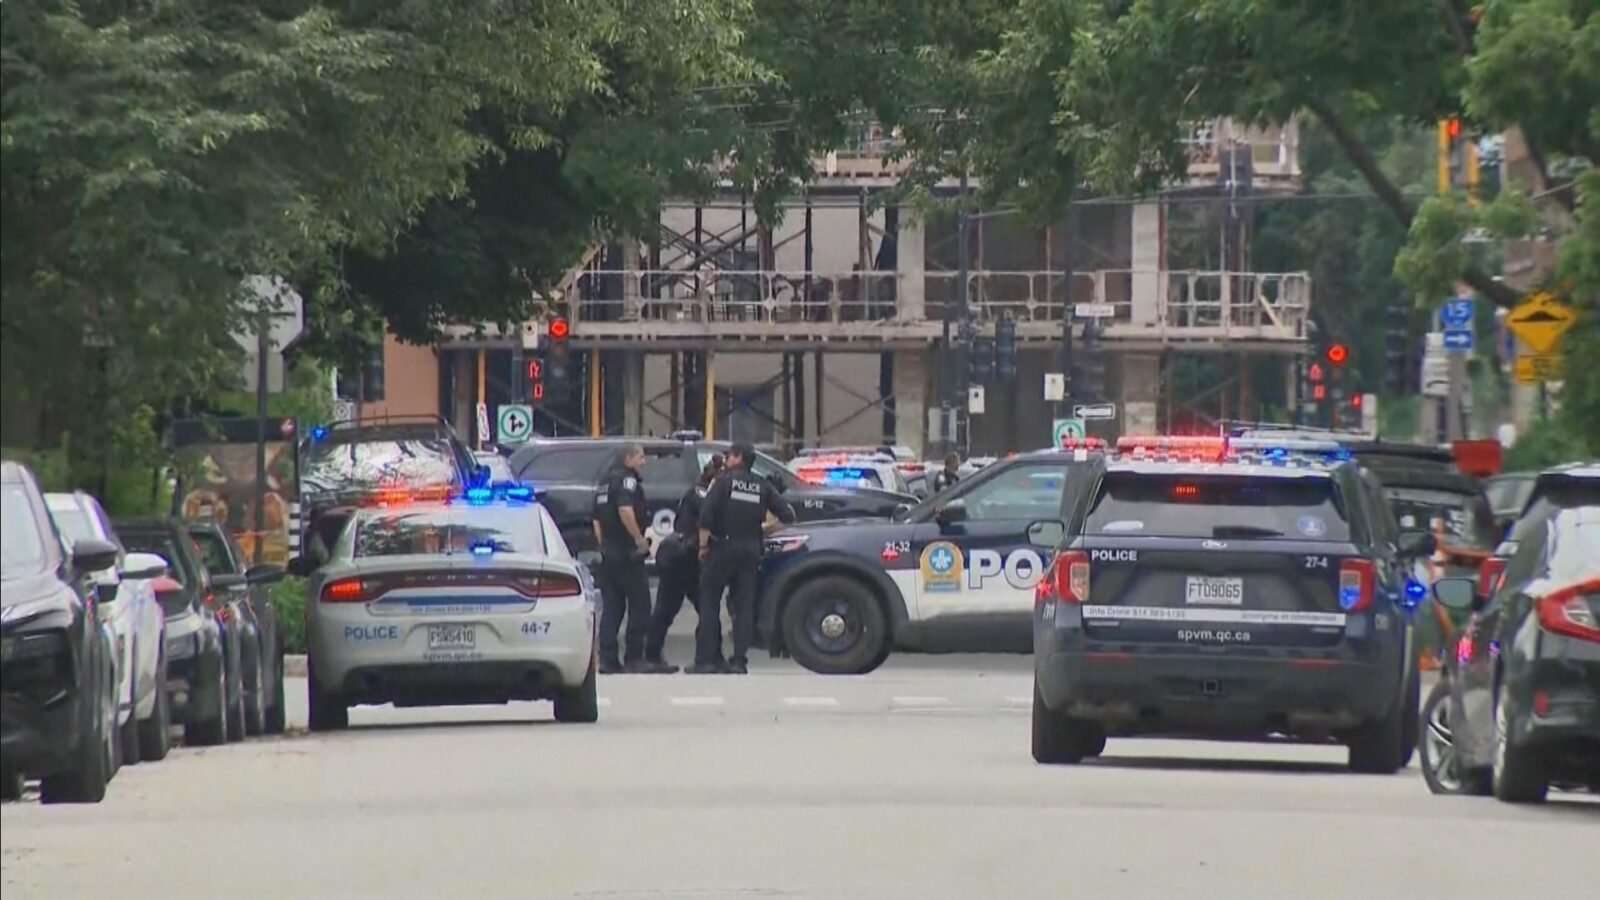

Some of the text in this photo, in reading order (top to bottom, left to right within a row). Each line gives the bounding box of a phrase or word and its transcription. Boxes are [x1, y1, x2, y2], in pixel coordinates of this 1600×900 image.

[731, 479, 761, 493] POLICE
[1090, 549, 1138, 561] POLICE
[1305, 555, 1329, 568] 27-4
[343, 624, 399, 640] POLICE
[520, 621, 551, 634] 44-7
[1177, 628, 1251, 643] spvm.qc.ca
